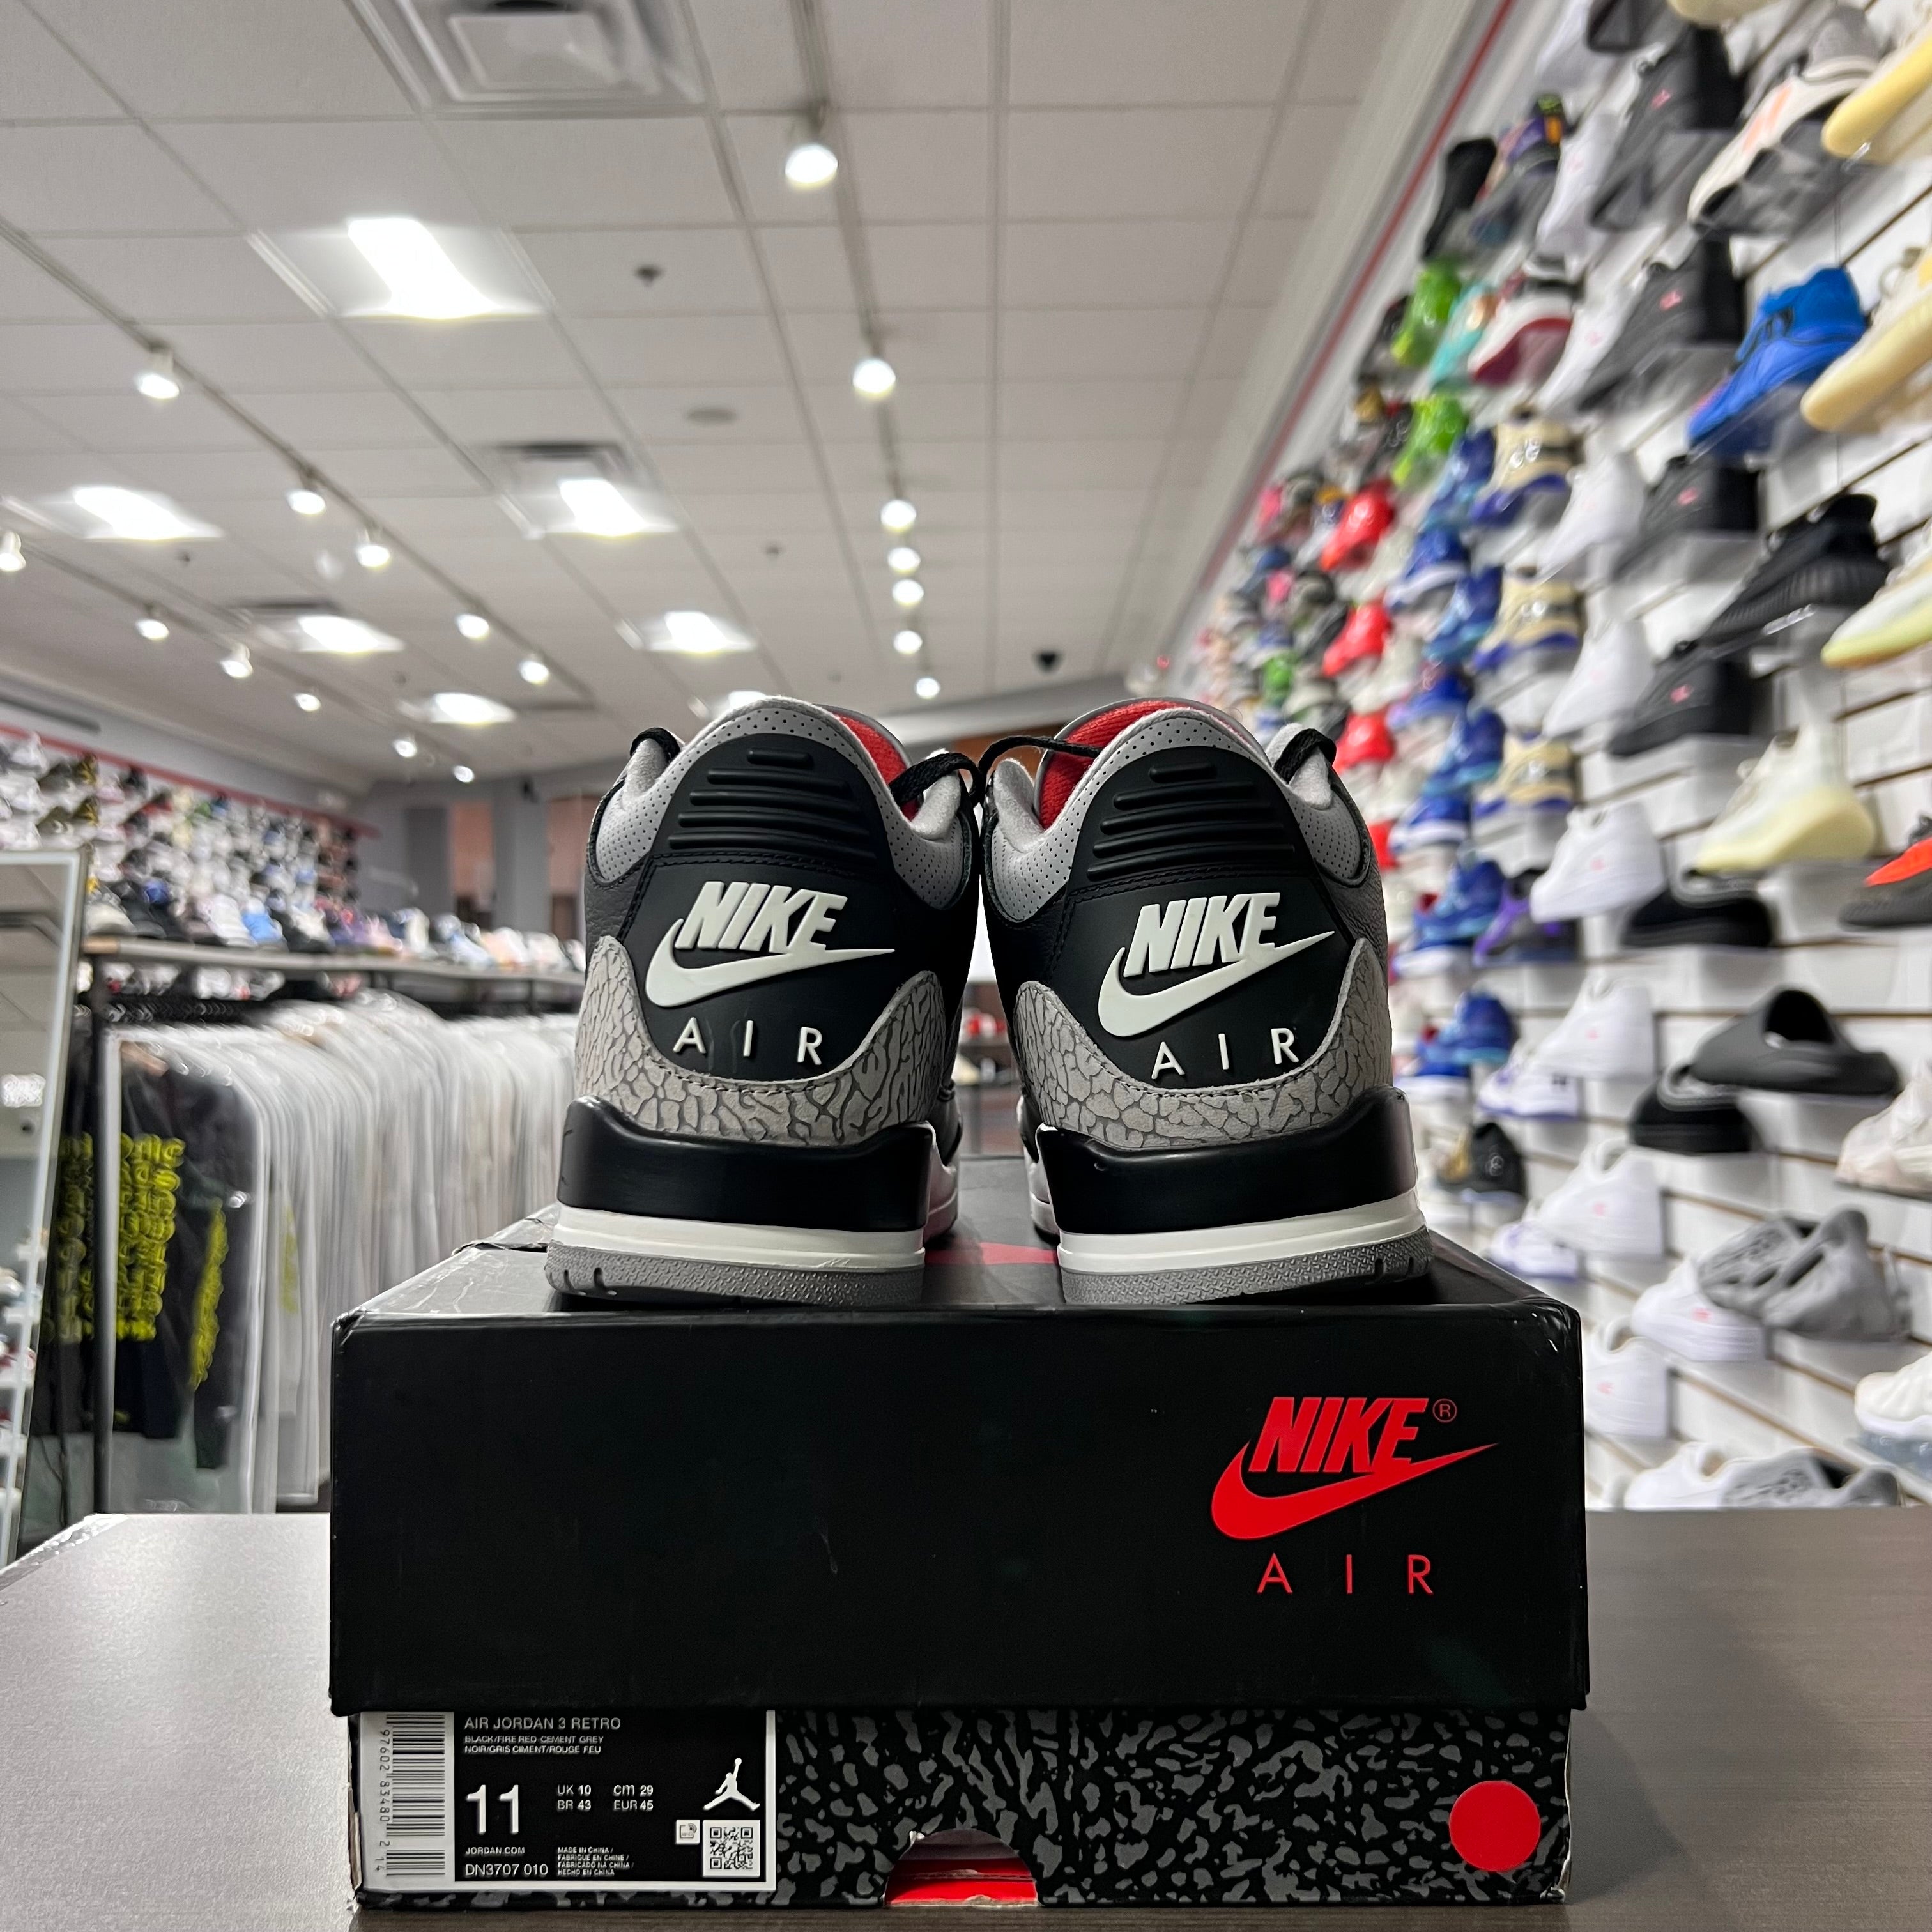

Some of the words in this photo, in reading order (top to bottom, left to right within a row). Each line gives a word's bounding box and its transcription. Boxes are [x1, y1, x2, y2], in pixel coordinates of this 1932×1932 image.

[675, 881, 848, 953] NIKE
[1123, 892, 1280, 977] NIKE
[673, 1017, 823, 1065] AIR
[1151, 1028, 1299, 1080] AIR
[1248, 1396, 1429, 1473] NIKE
[1257, 1552, 1434, 1594] AIR
[464, 1717, 489, 1729] AIR
[493, 1717, 553, 1731] JORDAN
[558, 1717, 566, 1729] 3
[571, 1717, 621, 1730] RETRO
[464, 1735, 517, 1744] BLACK/FIRE
[579, 1735, 604, 1744] GREY
[464, 1745, 510, 1754] NOIR/GRIS
[512, 1745, 580, 1754] CIMENT/ROUGE
[583, 1745, 601, 1754] FEU
[557, 1784, 574, 1796] UK
[578, 1785, 592, 1796] 10
[640, 1785, 654, 1796] 29
[466, 1784, 519, 1834] 11
[557, 1800, 574, 1811] BR
[578, 1800, 592, 1811] 43
[613, 1800, 638, 1811] EUR
[640, 1800, 654, 1811] 45
[465, 1863, 520, 1876] DN3707
[523, 1863, 548, 1876] 010
[609, 1861, 630, 1869] CHINA
